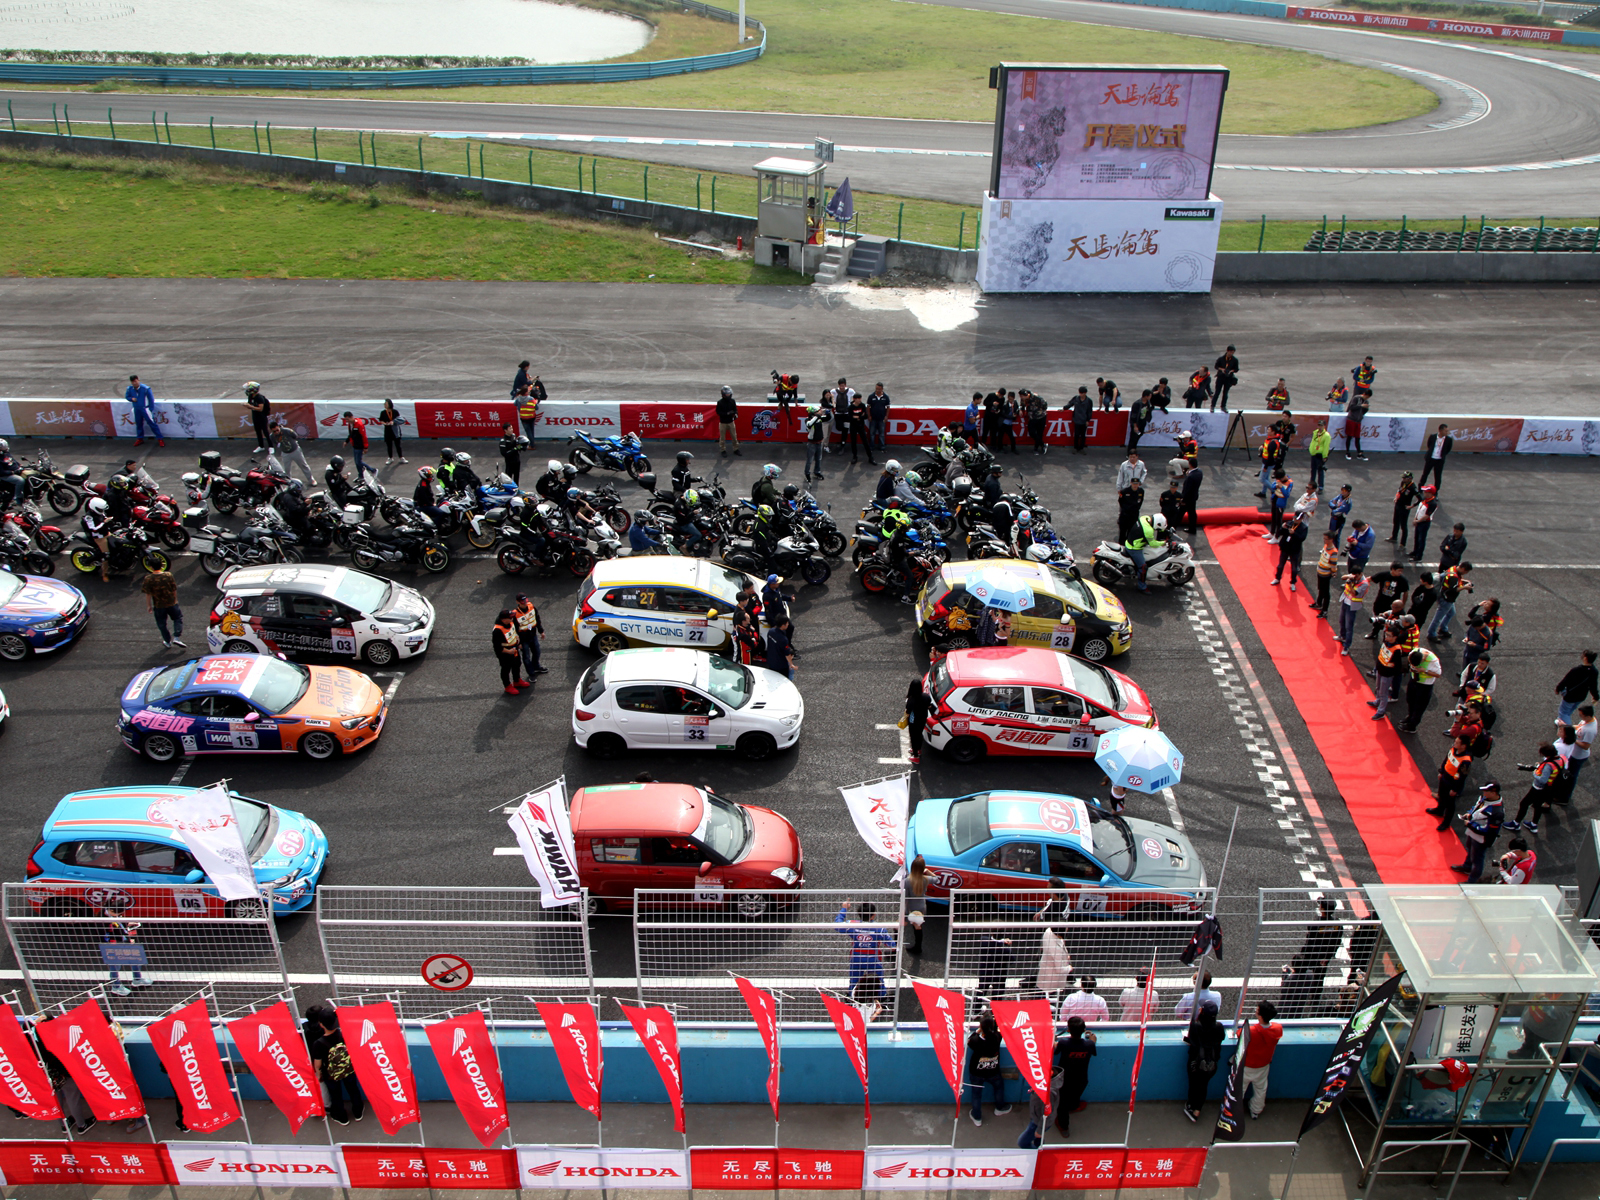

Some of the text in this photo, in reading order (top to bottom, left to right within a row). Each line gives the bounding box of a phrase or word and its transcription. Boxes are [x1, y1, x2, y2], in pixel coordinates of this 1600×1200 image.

[1310, 11, 1408, 26] HONDA 新大洲本田
[1443, 23, 1551, 40] HONDA 新大洲本田
[1083, 123, 1186, 148] 开幕仪式
[1170, 209, 1210, 217] Kawasaki
[435, 411, 500, 421] 无尽飞驰
[545, 417, 615, 426] HONDA
[639, 412, 704, 423] 无尽飞驰
[225, 597, 242, 608] STP
[640, 592, 655, 604] 27
[620, 623, 683, 637] GYT RACING
[689, 630, 703, 641] 27
[337, 640, 351, 651] 03
[1055, 636, 1069, 647] 28
[968, 706, 1029, 720] LINKY RACING
[237, 735, 253, 746] 15
[689, 729, 704, 740] 33
[1073, 737, 1088, 748] 51
[1128, 777, 1142, 785] STP
[1043, 802, 1069, 830] STP
[280, 831, 301, 854] STP
[1145, 840, 1160, 857] STP
[936, 872, 959, 886] STP
[293, 888, 305, 898] STP
[181, 898, 201, 910] 06
[1083, 898, 1102, 911] 07
[1456, 1004, 1479, 1053] 推迟发车
[1508, 1075, 1537, 1085] 5
[1498, 1086, 1513, 1101] sec
[30, 1154, 142, 1166] 无尽飞驰
[378, 1159, 488, 1171] 无尽飞驰
[1066, 1158, 1173, 1172] 无尽飞驰
[218, 1162, 338, 1174] HONDA
[563, 1166, 681, 1177] HONDA
[723, 1161, 832, 1172] 无尽飞驰
[908, 1167, 1024, 1178] HONDA
